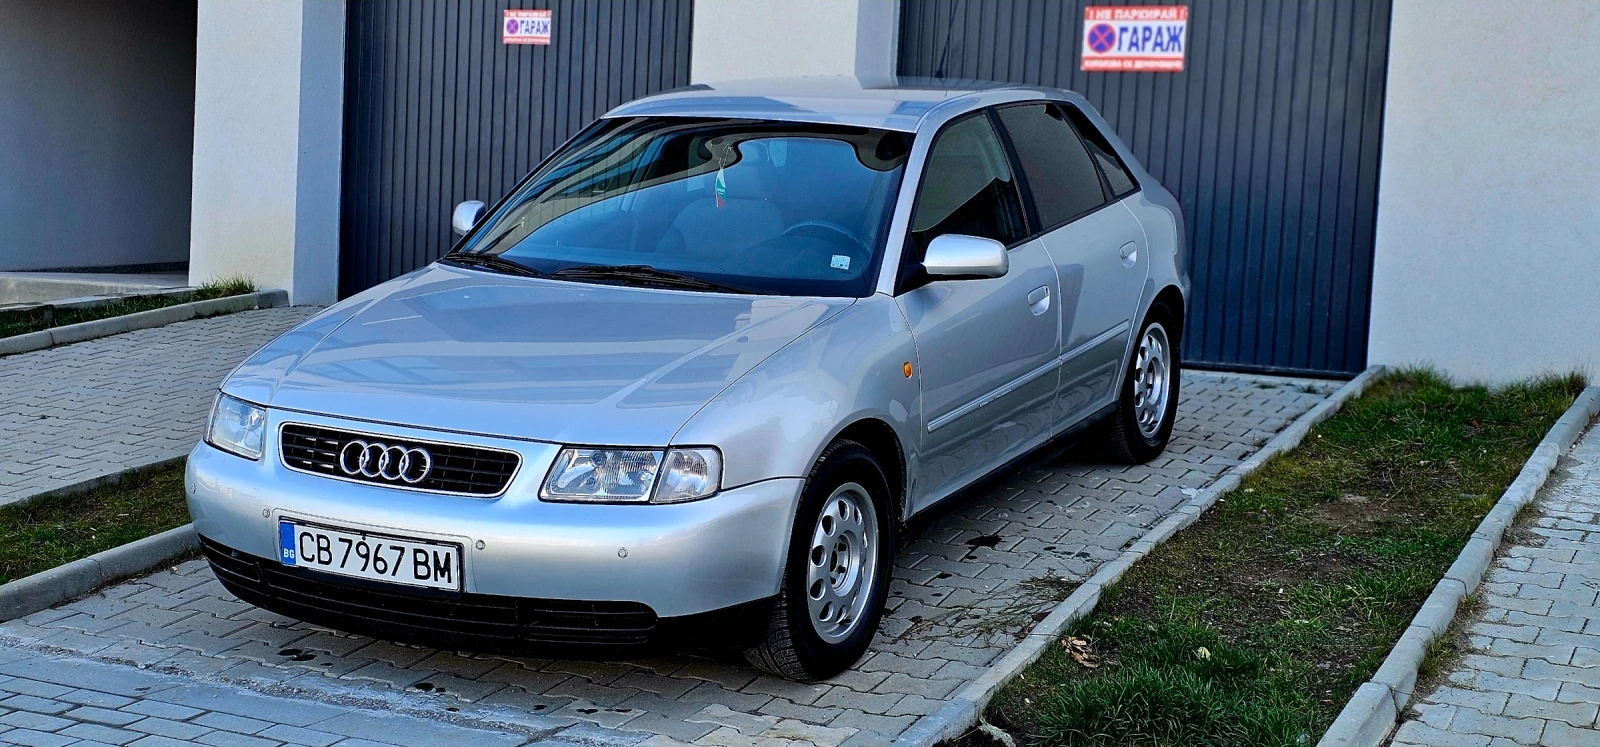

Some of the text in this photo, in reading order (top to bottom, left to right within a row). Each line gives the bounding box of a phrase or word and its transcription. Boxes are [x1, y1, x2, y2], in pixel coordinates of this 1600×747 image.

[519, 20, 550, 35] ГАРАЖ
[1117, 25, 1183, 52] ГАРАЖ
[283, 548, 295, 559] BG
[299, 531, 453, 584] CB 7967 BM
